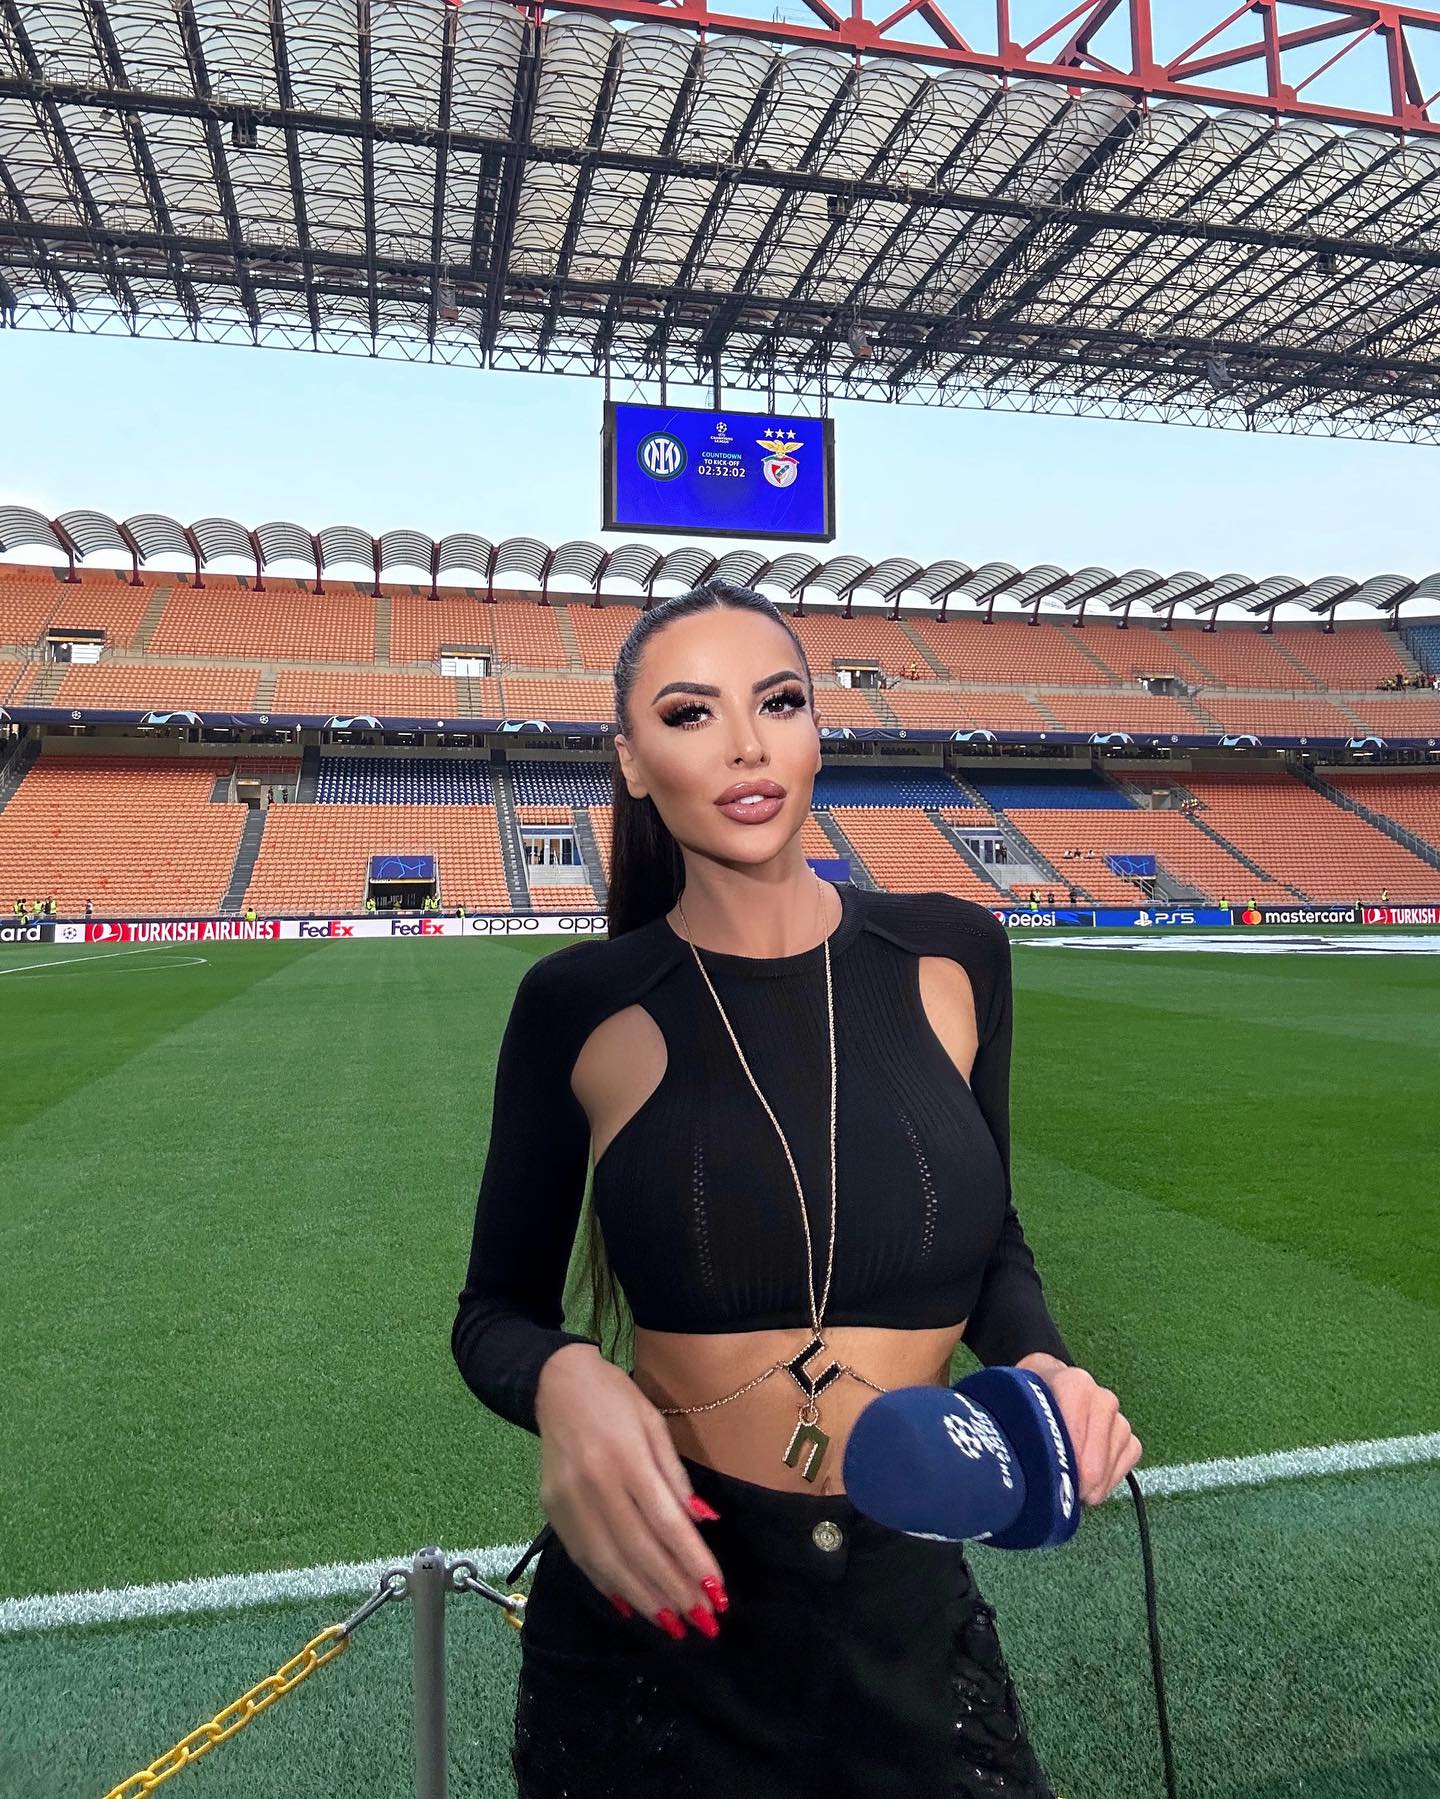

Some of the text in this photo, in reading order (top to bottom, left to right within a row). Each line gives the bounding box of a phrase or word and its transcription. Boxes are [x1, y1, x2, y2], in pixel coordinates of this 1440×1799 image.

[702, 451, 742, 460] COUNTDOWN
[714, 459, 741, 467] KICK-OFF
[698, 465, 746, 478] 02:32:02
[1008, 911, 1056, 928] pepsi
[1155, 912, 1195, 925] PS5
[1265, 909, 1355, 924] mastercard
[1390, 908, 1436, 924] TURKISH
[128, 920, 274, 942] TURKISH AIRLINES
[299, 920, 354, 938] FedEx
[391, 919, 445, 936] FedEx
[472, 918, 540, 934] oppo
[558, 917, 609, 933] opp
